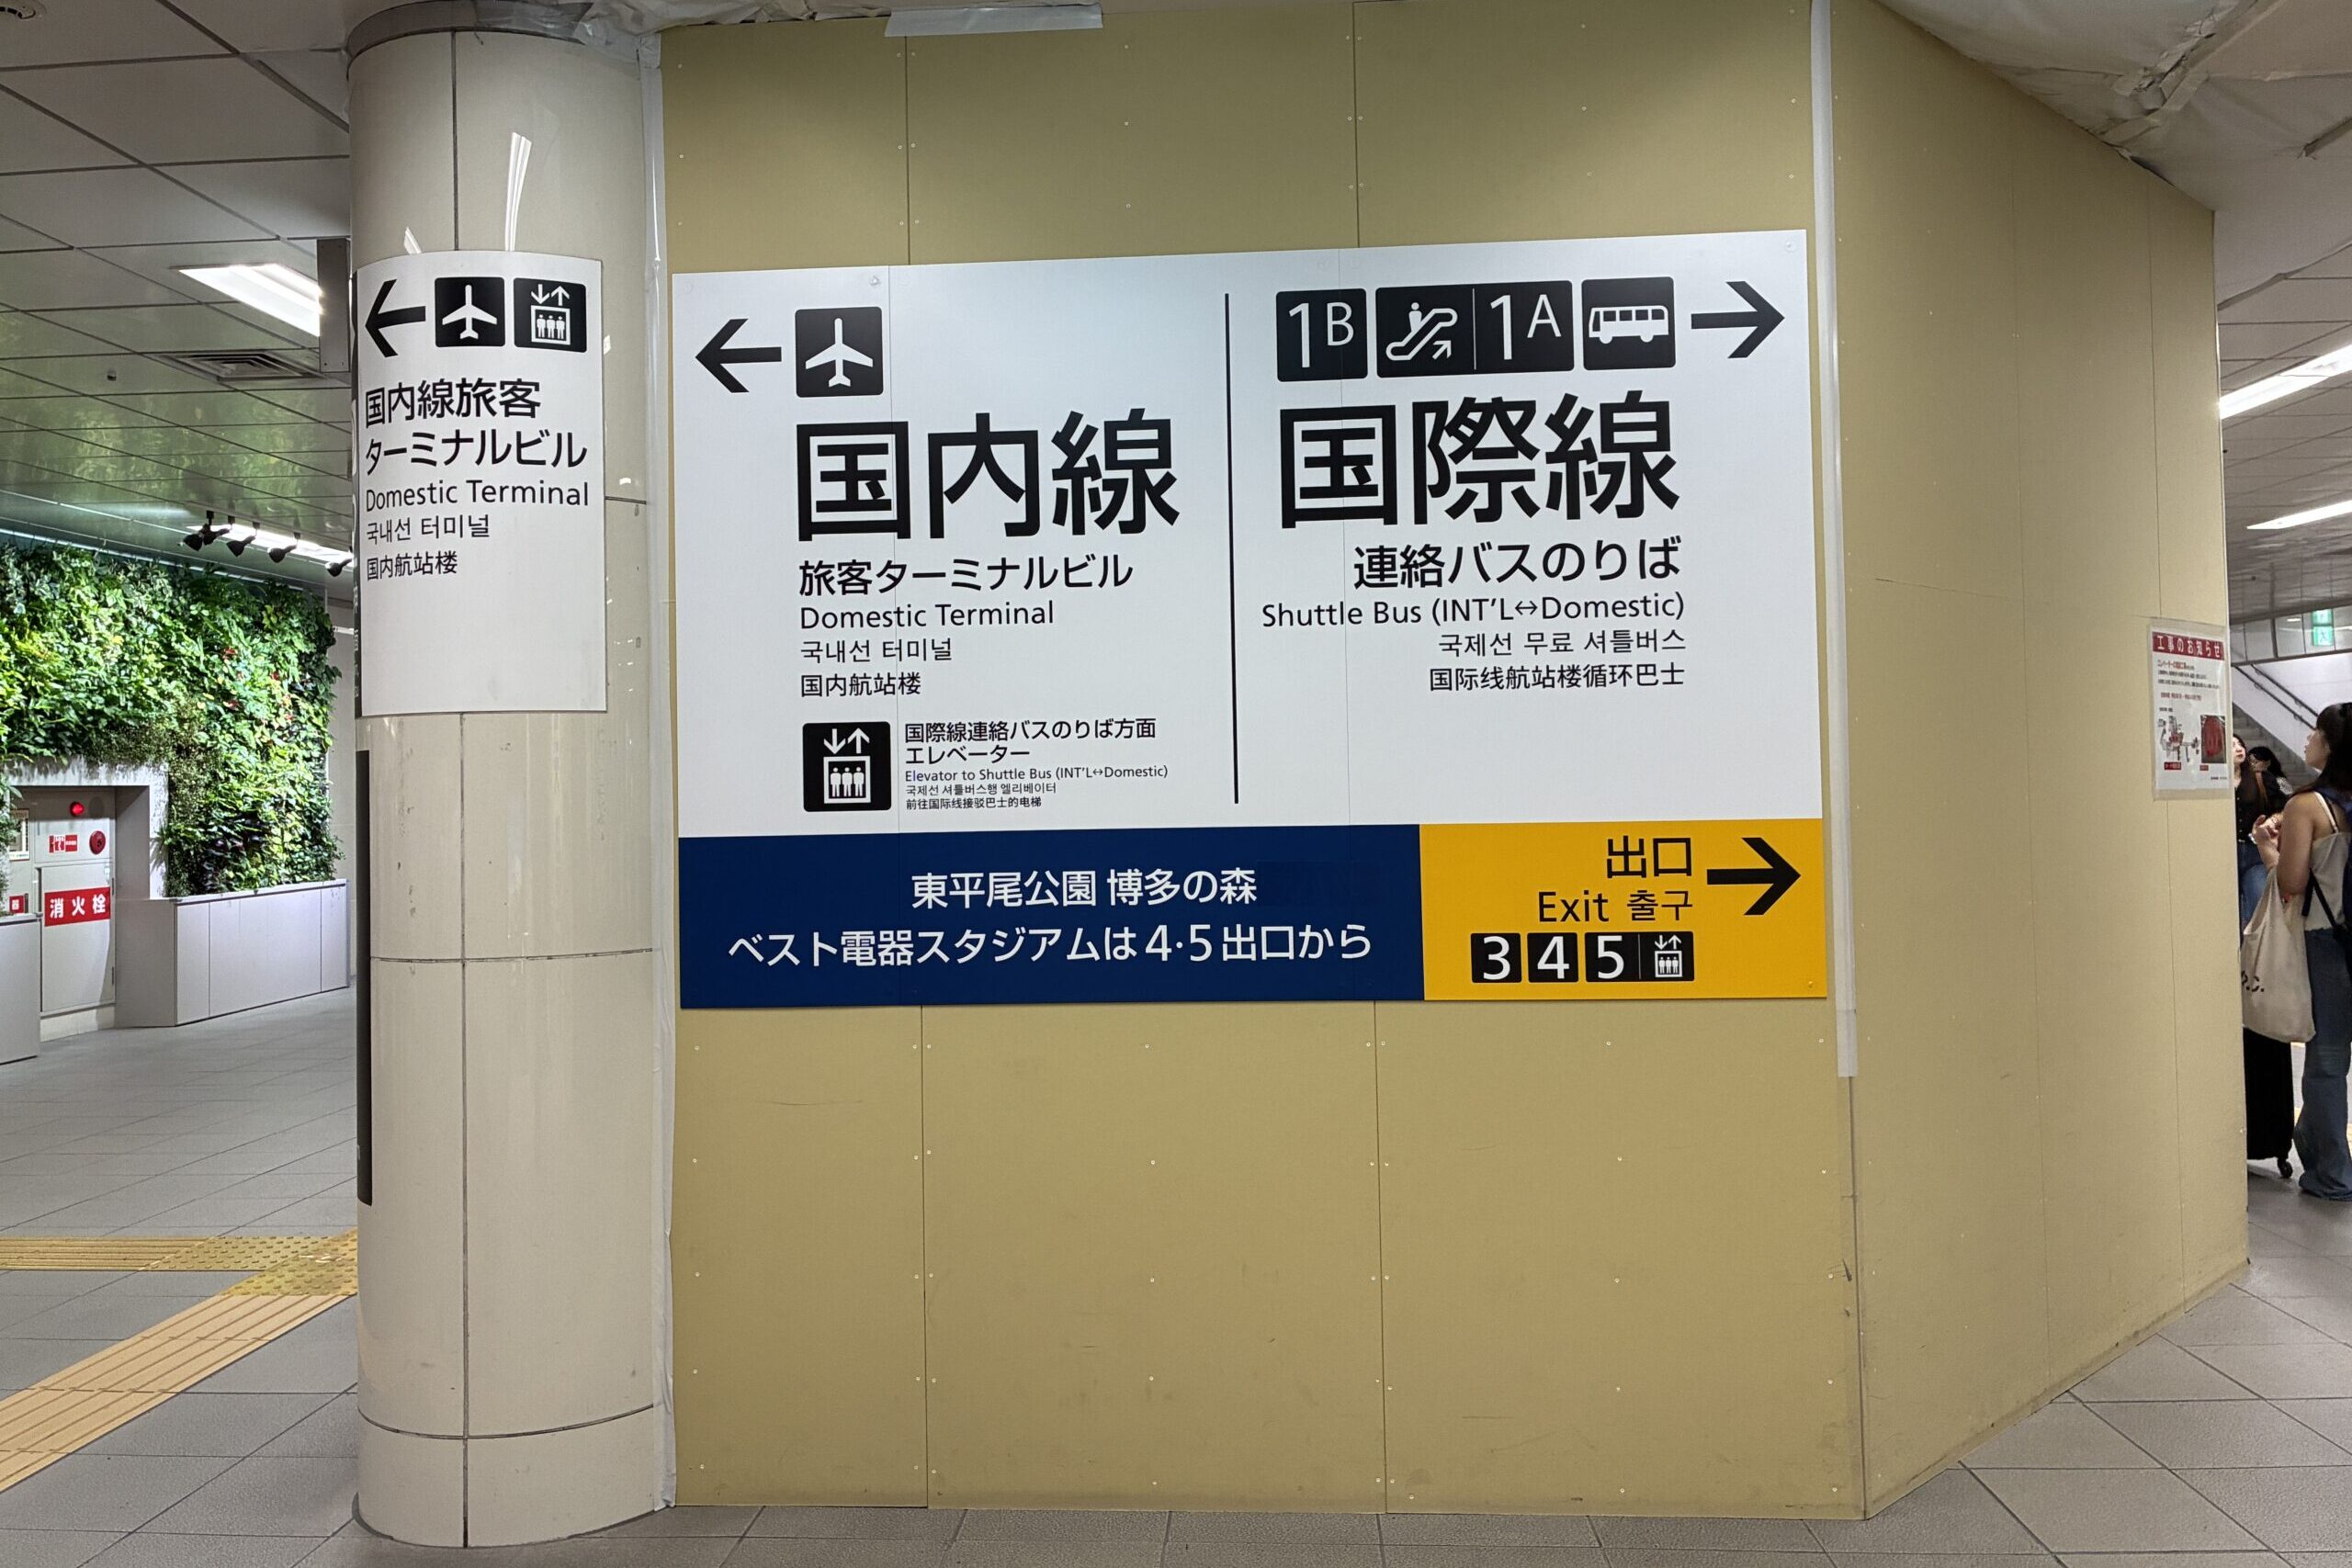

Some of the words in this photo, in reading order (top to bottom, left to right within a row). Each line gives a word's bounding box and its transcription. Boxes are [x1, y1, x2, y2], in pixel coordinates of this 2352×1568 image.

[1288, 301, 1355, 368] 1B
[1490, 294, 1562, 360] 1A
[365, 377, 541, 427] 国内線旅客
[366, 428, 588, 477] ターミナルビル
[1279, 389, 1680, 529] 国際線
[796, 407, 1181, 542] 国内線
[366, 479, 458, 513] Domestic
[465, 479, 589, 507] Terminal
[366, 517, 412, 546] 국내선
[421, 513, 491, 540] 터미널
[366, 550, 458, 581] 国内航站楼
[798, 553, 1134, 597] 旅客ターミナルビル
[1353, 535, 1682, 591] 連絡バスのりば
[800, 604, 927, 629] Domestic
[934, 600, 1054, 626] Terminal
[1262, 601, 1363, 627] Shuttle
[1374, 601, 1422, 625] Bus
[800, 639, 871, 664] 국내선
[882, 637, 952, 662] 터미널
[1438, 632, 1512, 656] 국제선
[1523, 632, 1574, 655] 무료
[1583, 628, 1686, 654] 셔틀버스
[2156, 635, 2221, 658] 工事のお知らせ
[800, 671, 922, 698] 国内航站楼
[1430, 661, 1685, 692] 国际线航站楼循环巴士
[905, 717, 1157, 743] 国際線連絡バスのりば方面
[905, 744, 1030, 765] エレベーター
[905, 770, 958, 782] Elevator
[962, 770, 976, 781] to
[979, 768, 1025, 781] Shuttle
[1030, 768, 1052, 780] Bus
[906, 784, 939, 796] 국제선
[1001, 782, 1057, 795] 엘리베이터
[1606, 835, 1692, 879] 出口
[911, 870, 1097, 909] 東平尾公園
[1106, 866, 1258, 907] 博多の森
[50, 893, 107, 919] 消火栓
[1538, 889, 1610, 922] Exit
[1626, 889, 1693, 921] 출구
[1483, 935, 1511, 980] 3
[1537, 935, 1570, 979] 4
[1597, 935, 1624, 979] 5
